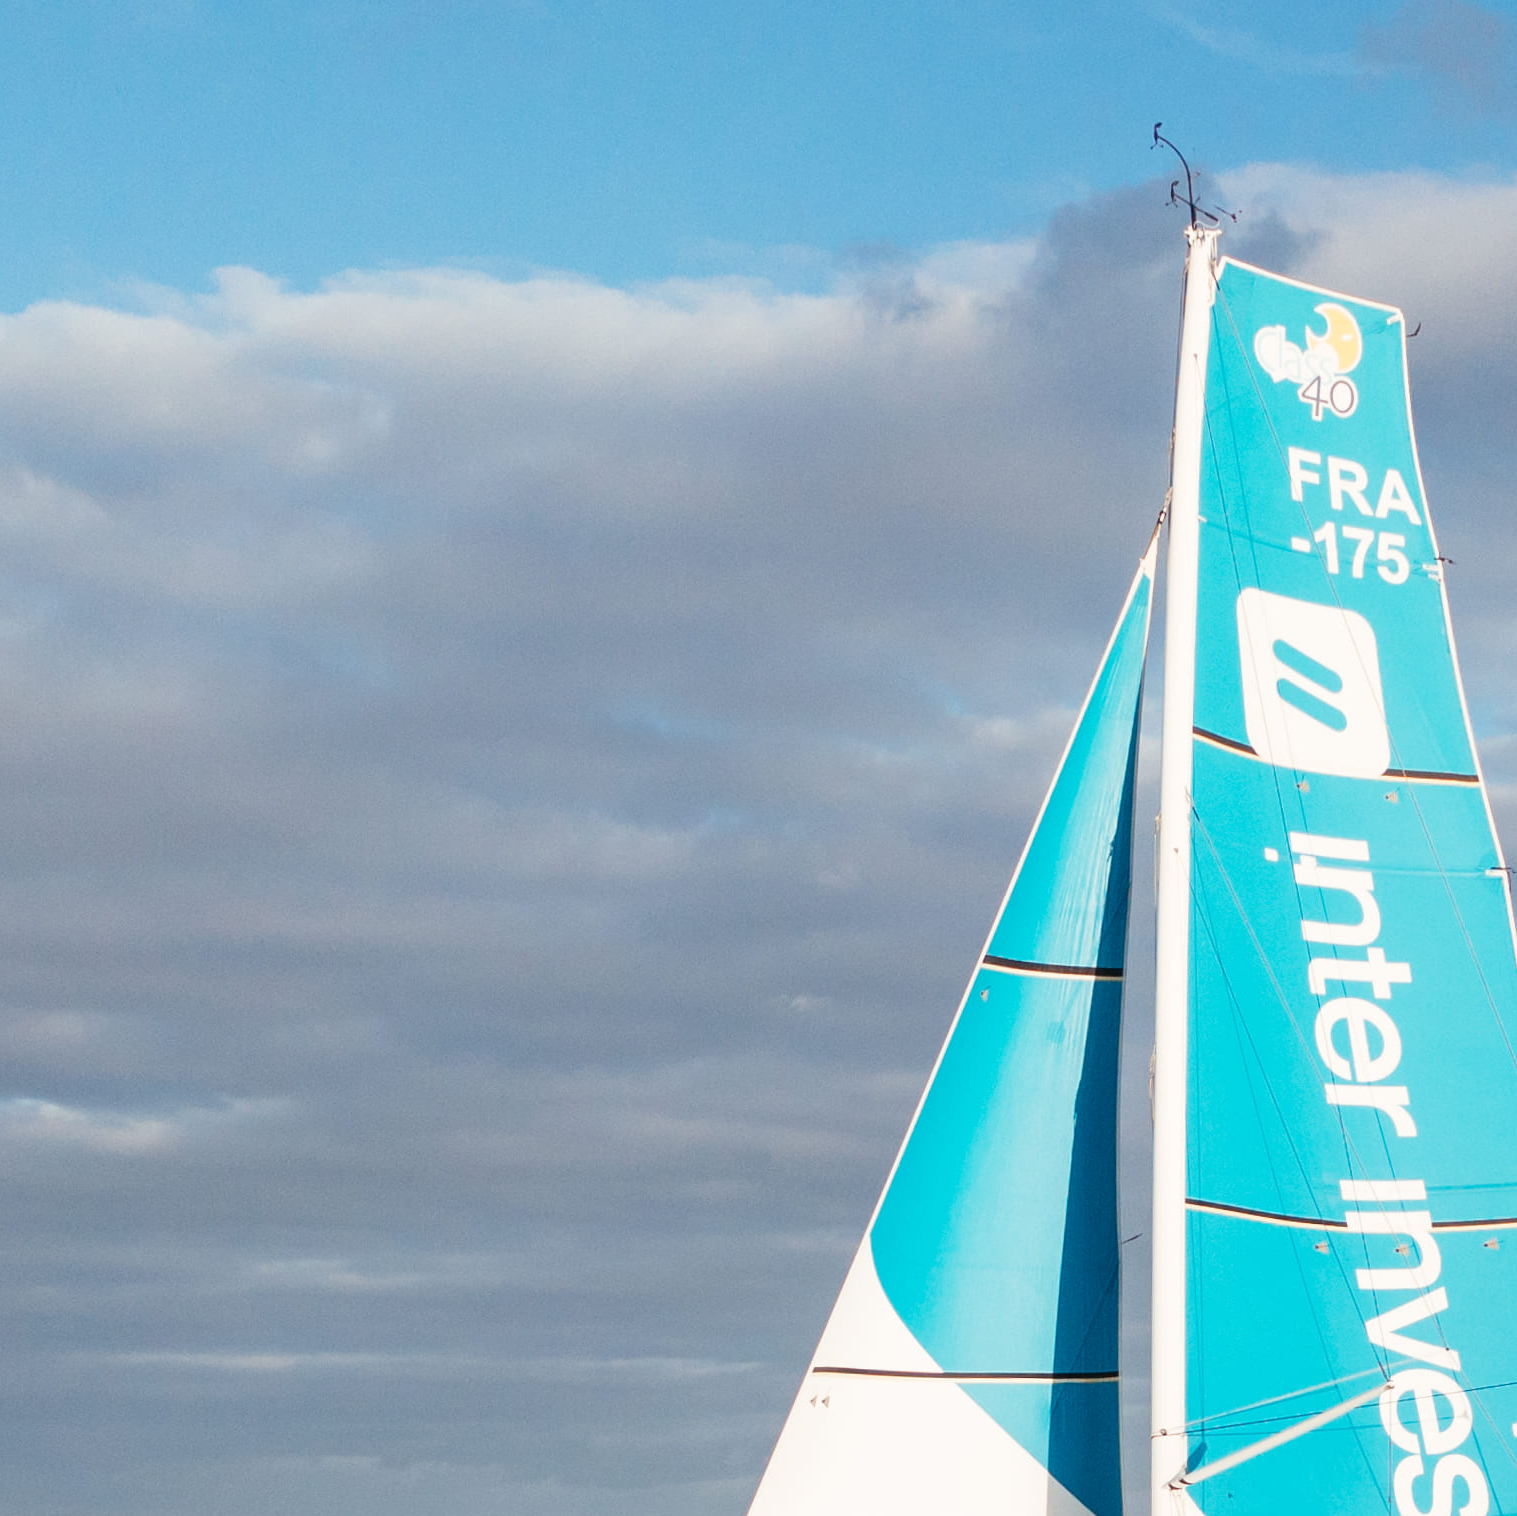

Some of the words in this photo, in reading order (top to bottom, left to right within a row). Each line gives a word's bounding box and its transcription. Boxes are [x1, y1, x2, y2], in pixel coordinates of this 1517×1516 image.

[1301, 375, 1355, 417] 40
[1287, 446, 1422, 526] FRA
[1290, 520, 1411, 585] -175
